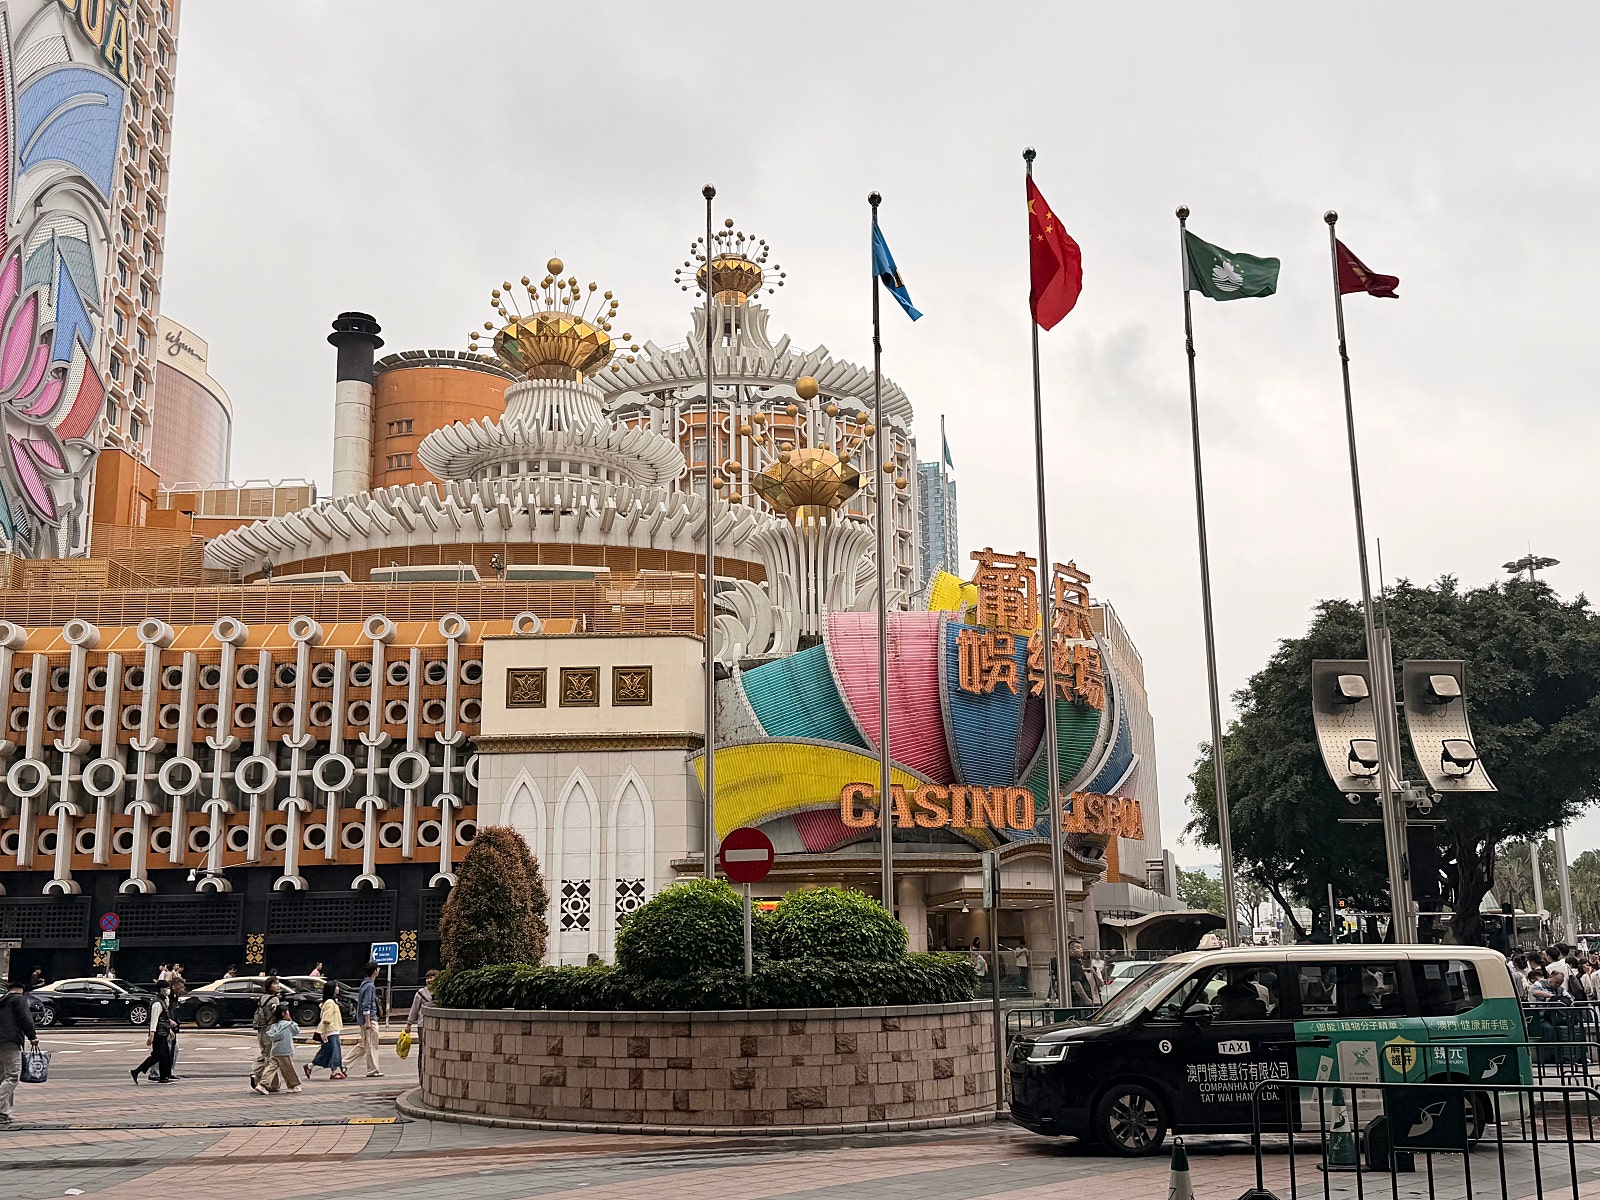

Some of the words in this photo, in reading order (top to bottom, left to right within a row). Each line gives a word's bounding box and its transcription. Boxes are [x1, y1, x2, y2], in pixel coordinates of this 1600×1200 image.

[969, 547, 1094, 641] 葡京
[840, 781, 1035, 831] CASINO
[1436, 1020, 1457, 1031] 澳門
[1459, 1019, 1509, 1031] 健康新手信
[1162, 1042, 1169, 1051] 6
[1220, 1043, 1249, 1052] TAXI
[1186, 1062, 1290, 1082] 澳門博達慧行有限公司
[1199, 1082, 1248, 1092] COMPANHIA
[1200, 1093, 1215, 1103] TAT
[1217, 1093, 1233, 1103] WAI
[1235, 1092, 1254, 1102] HAN
[1261, 1091, 1280, 1101] LDA.
